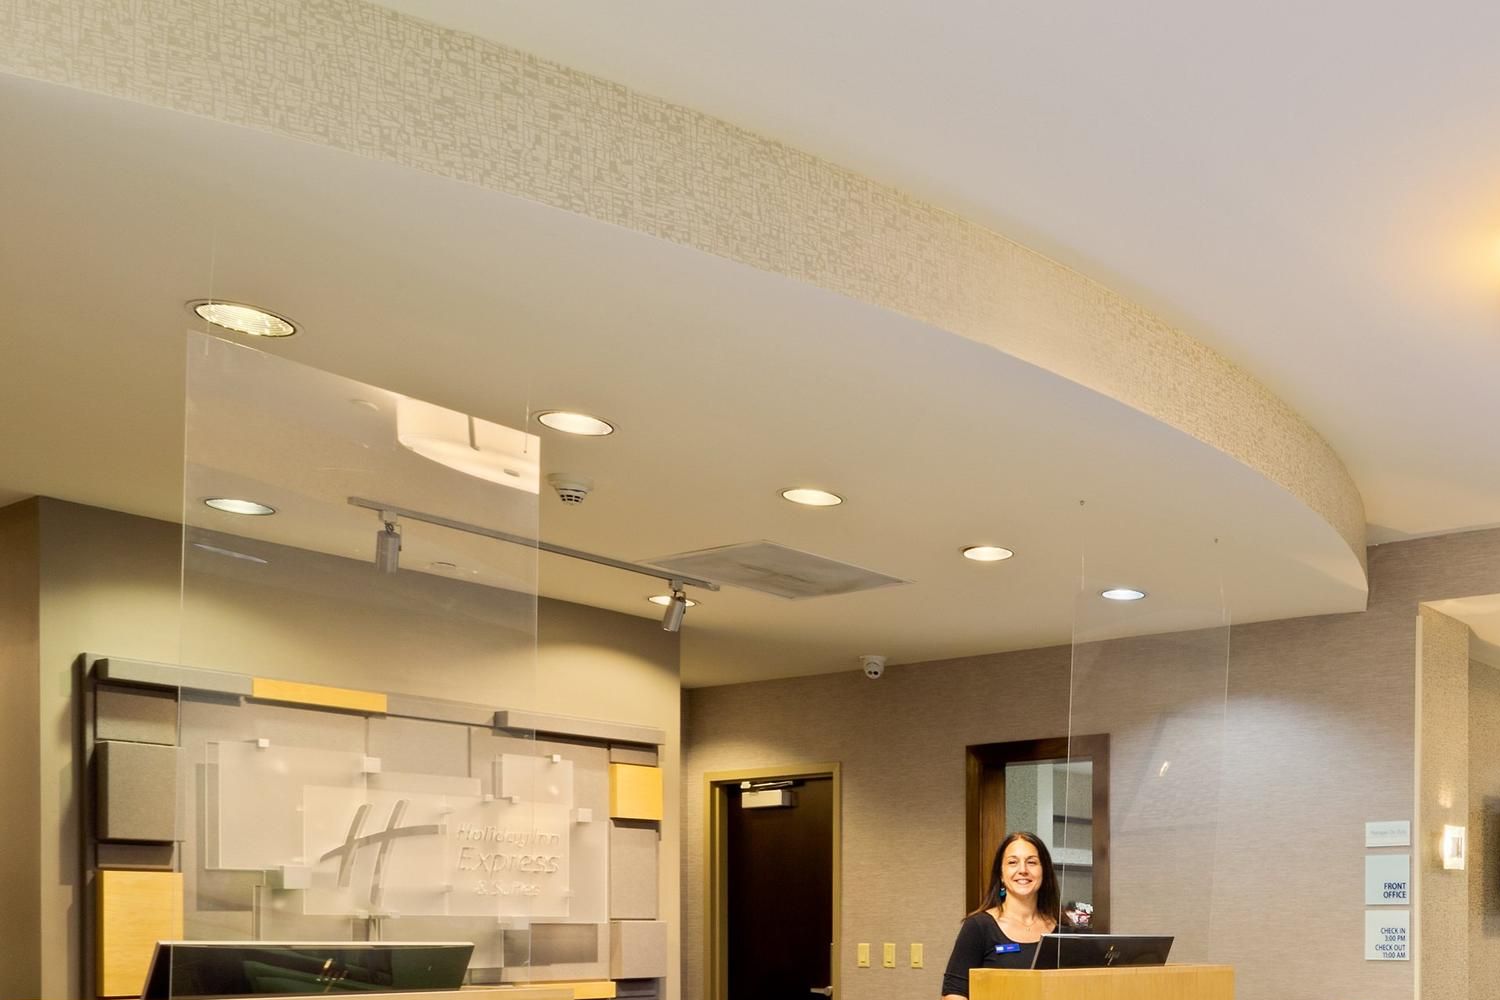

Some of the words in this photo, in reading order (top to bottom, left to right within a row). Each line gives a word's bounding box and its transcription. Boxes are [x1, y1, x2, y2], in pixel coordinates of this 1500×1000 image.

[458, 846, 560, 879] Express
[1384, 882, 1406, 890] FRONT
[1383, 890, 1407, 898] OFFICE
[1375, 943, 1393, 951] CHECK
[1393, 943, 1406, 951] OUT
[1383, 951, 1396, 959] 11:00
[1396, 951, 1406, 959] AM
